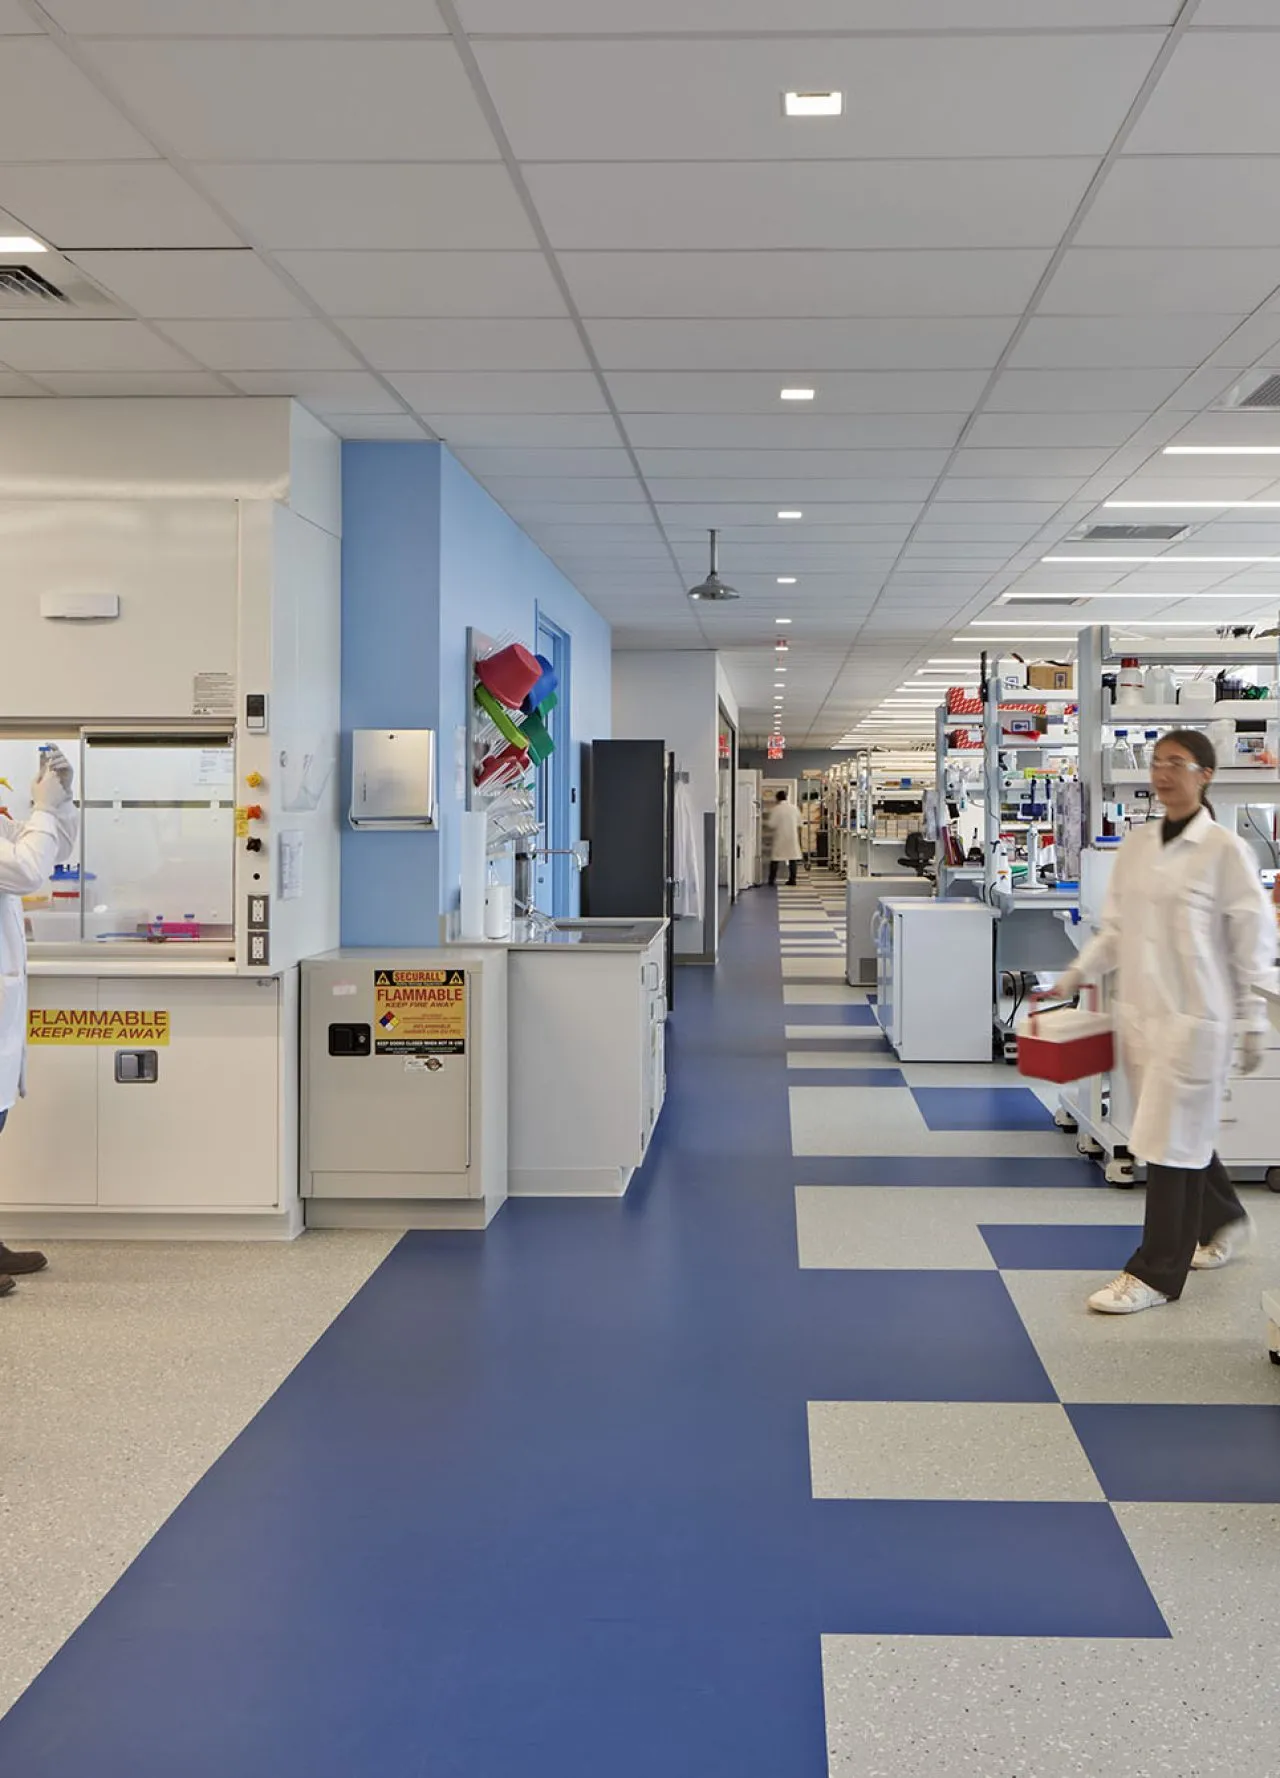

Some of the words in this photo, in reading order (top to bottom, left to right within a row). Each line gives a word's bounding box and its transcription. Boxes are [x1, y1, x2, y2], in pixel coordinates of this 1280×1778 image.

[377, 989, 463, 1001] FLAMMABLE
[29, 1009, 167, 1026] FLAMMABLE
[29, 1027, 73, 1038] KEEP
[76, 1027, 114, 1038] FIRE
[116, 1028, 167, 1039] AWAY
